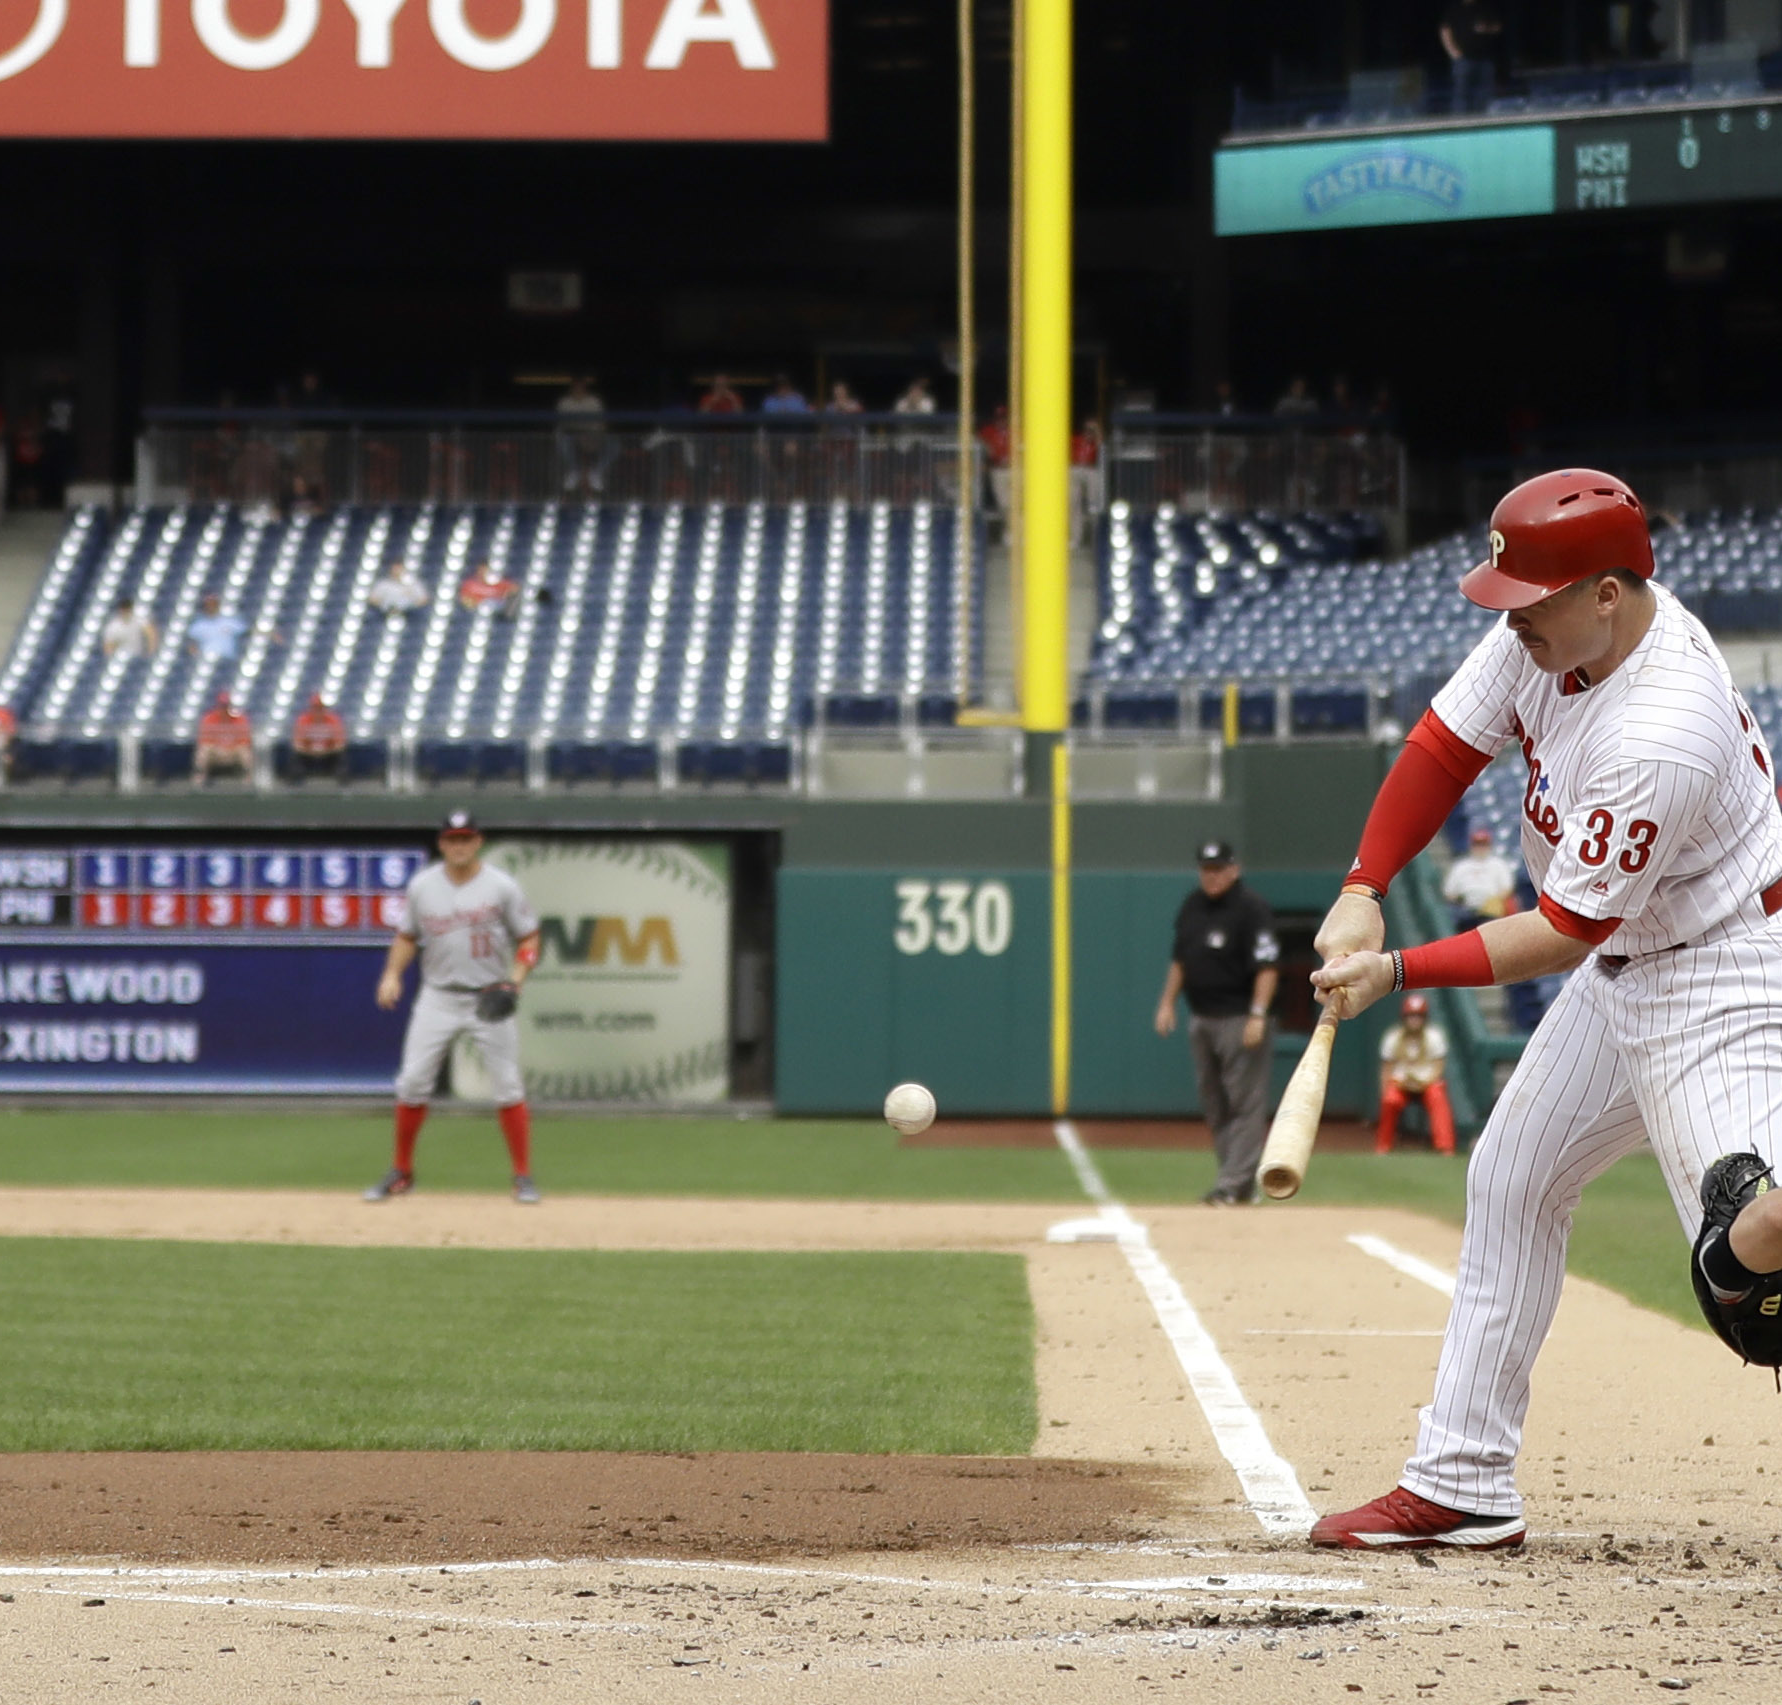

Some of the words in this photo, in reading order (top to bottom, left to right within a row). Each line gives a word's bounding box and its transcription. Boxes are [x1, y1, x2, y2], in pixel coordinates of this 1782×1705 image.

[1575, 143, 1630, 176] WSH
[1677, 137, 1701, 170] 0
[1576, 177, 1629, 210] PHI
[1490, 530, 1505, 568] P
[1579, 809, 1658, 873] 33
[95, 855, 118, 887] 1
[149, 855, 176, 887] 2
[206, 855, 234, 887] 3
[263, 854, 291, 885] 4
[321, 855, 350, 888] 5
[95, 893, 118, 927] 1
[149, 893, 176, 927] 2
[206, 893, 233, 927] 3
[263, 892, 290, 926] 4
[894, 880, 1012, 955] 330
[532, 1011, 656, 1031] wm.com
